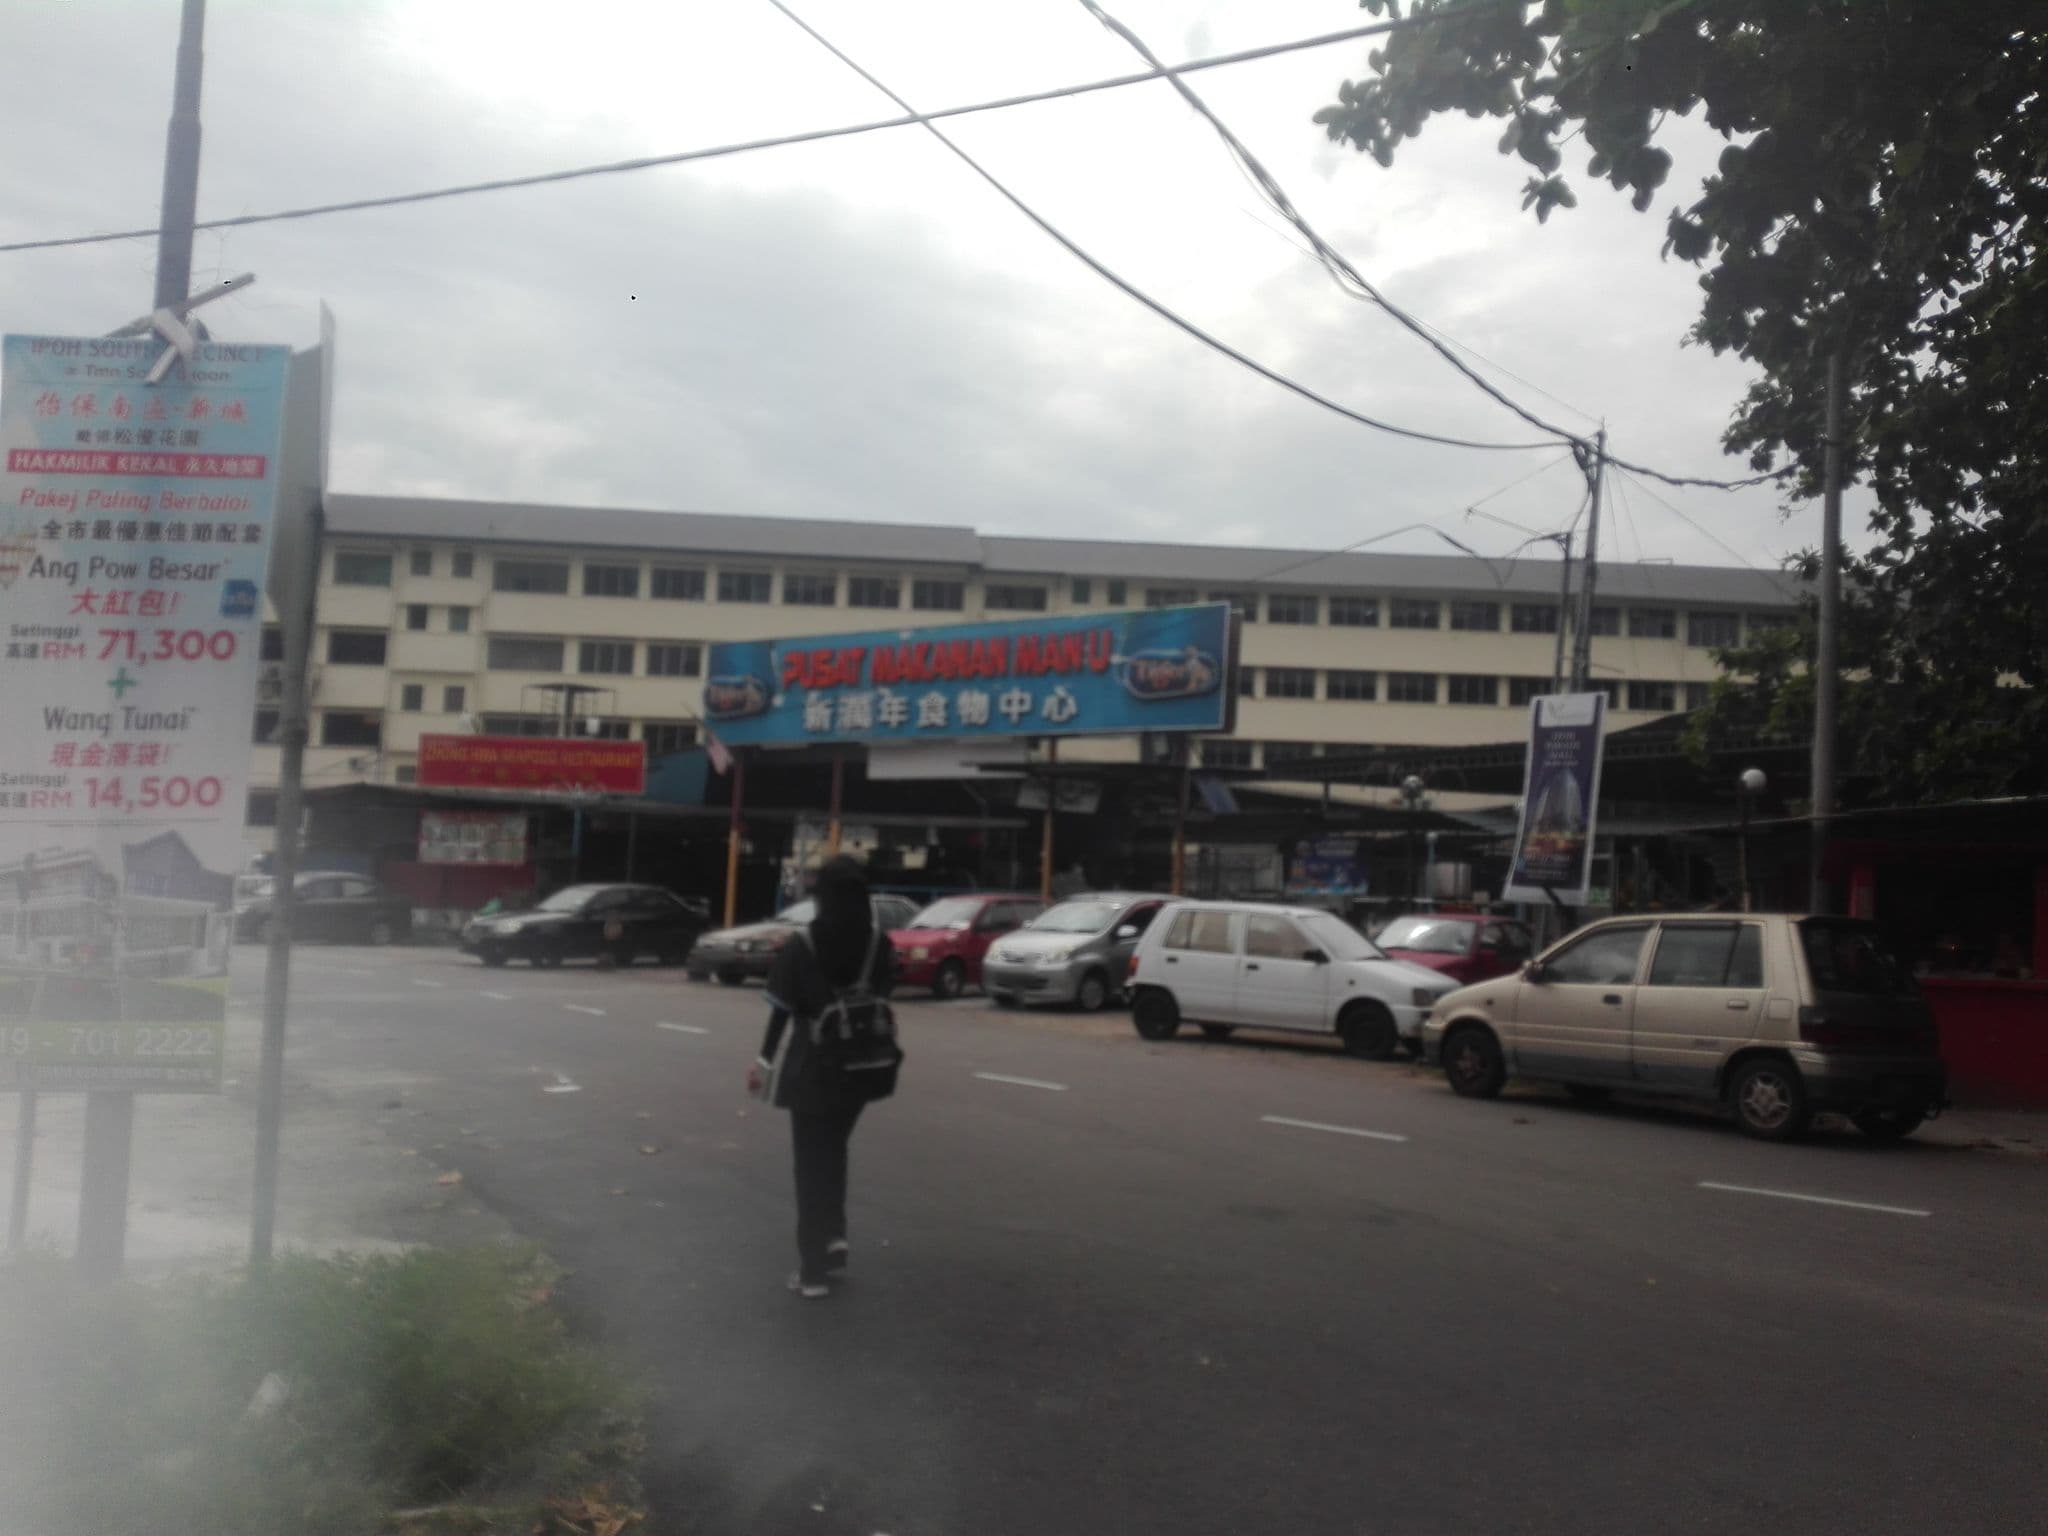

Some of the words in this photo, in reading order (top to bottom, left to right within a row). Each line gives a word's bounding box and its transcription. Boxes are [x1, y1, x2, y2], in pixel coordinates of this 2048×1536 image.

[14, 452, 109, 471] HAKMILIK
[116, 454, 178, 473] KEKAL
[86, 489, 150, 512] Paling
[27, 554, 80, 587] Ang
[87, 556, 138, 580] Pow
[97, 629, 236, 666] 71,300
[782, 646, 866, 690] PUSAT
[870, 631, 1009, 683] MAKANAN
[43, 706, 114, 737] Wang
[84, 776, 223, 813] 14,500
[134, 1027, 216, 1056] 2222
